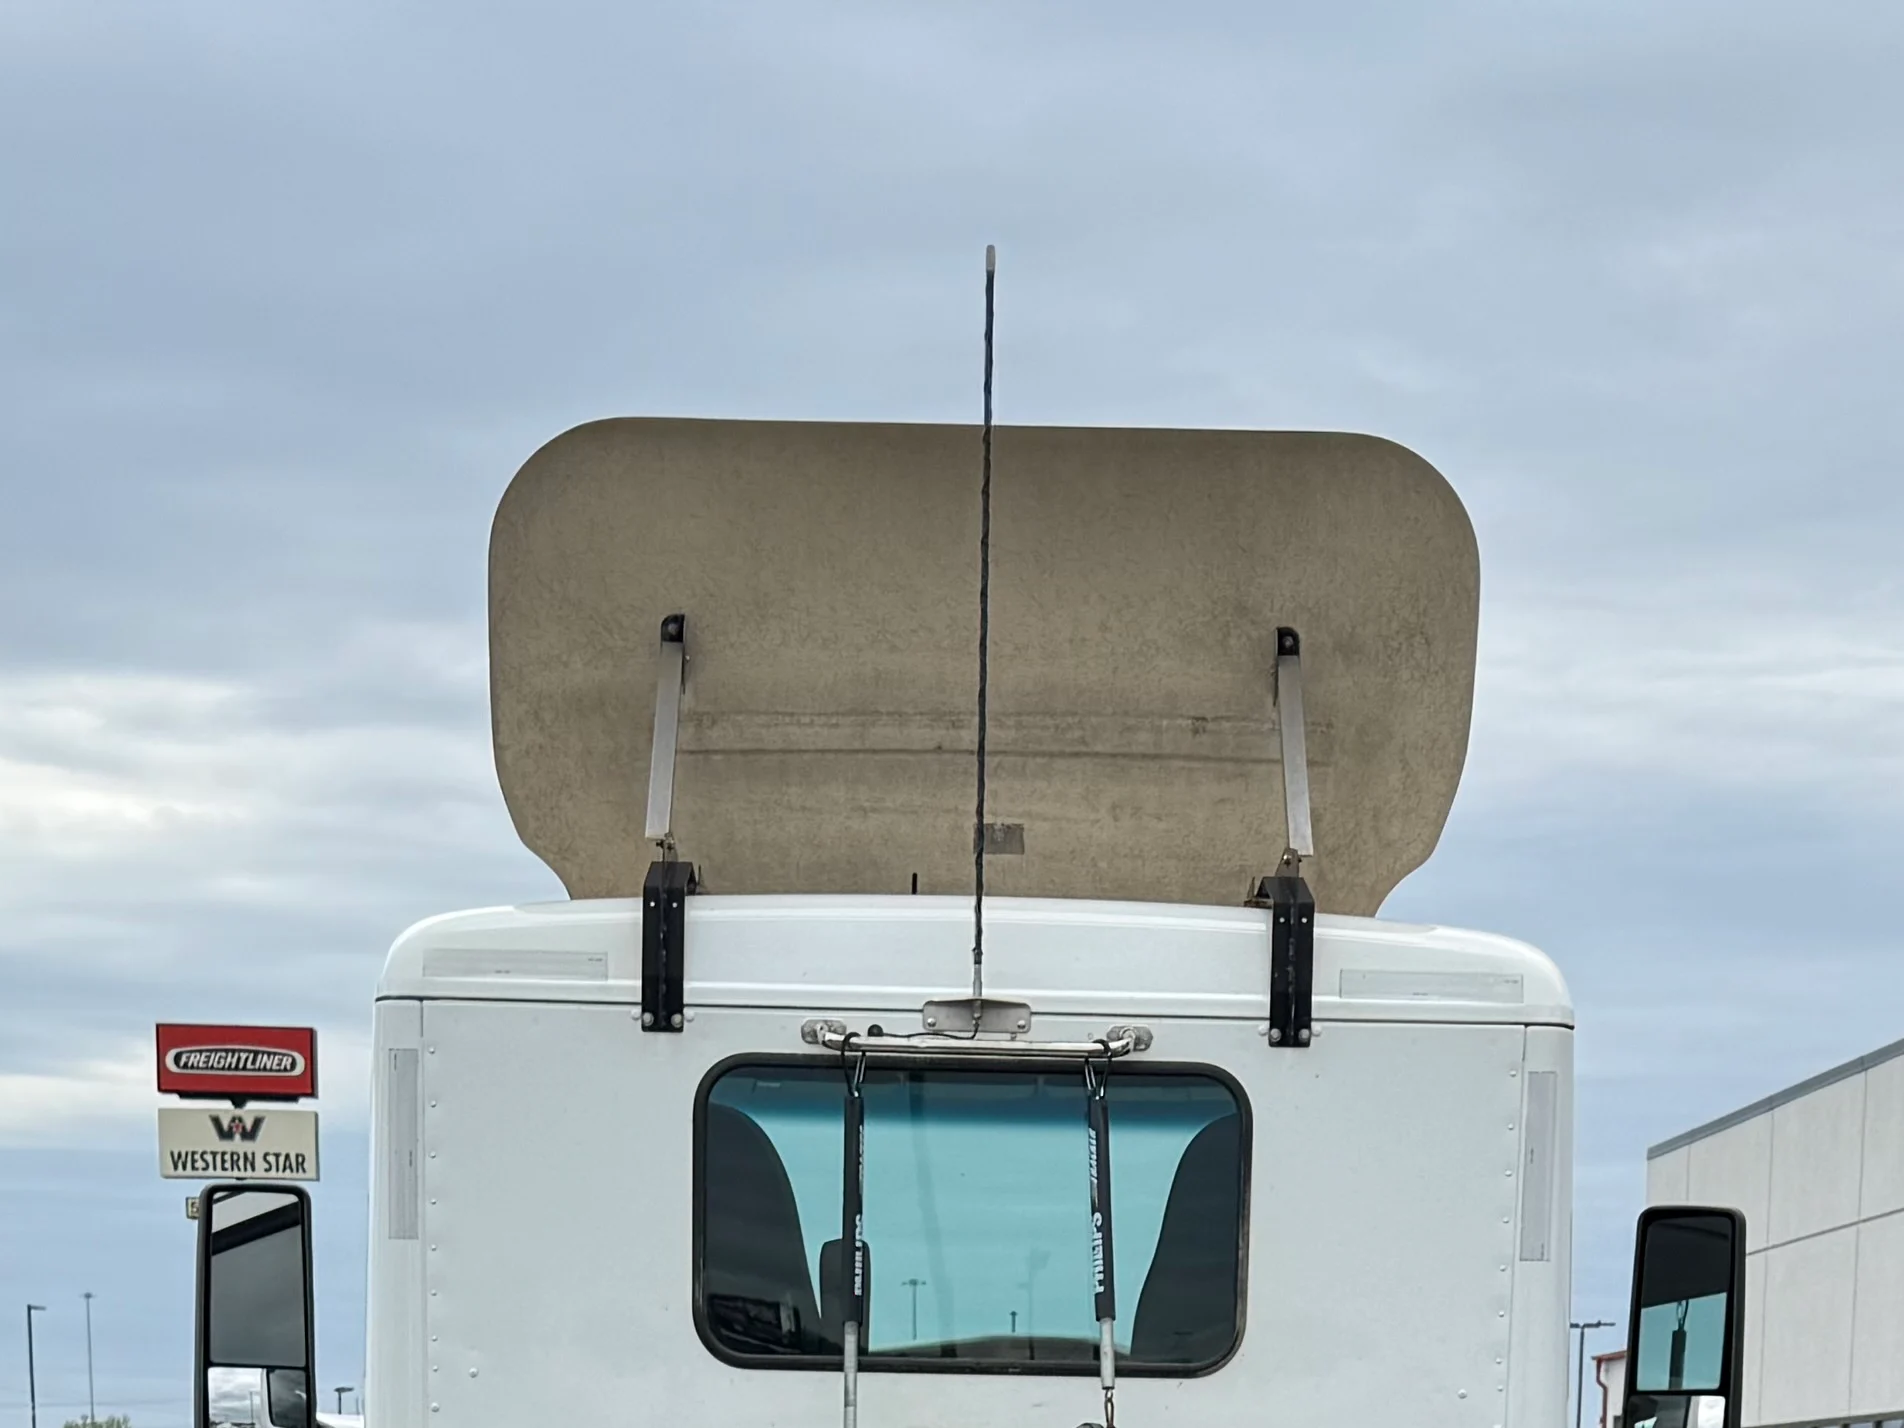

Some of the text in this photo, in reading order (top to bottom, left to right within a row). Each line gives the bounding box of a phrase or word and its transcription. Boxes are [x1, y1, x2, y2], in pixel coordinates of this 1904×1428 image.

[179, 1051, 293, 1070] FREIGHTLINER
[170, 1150, 306, 1174] WESTERN STAR
